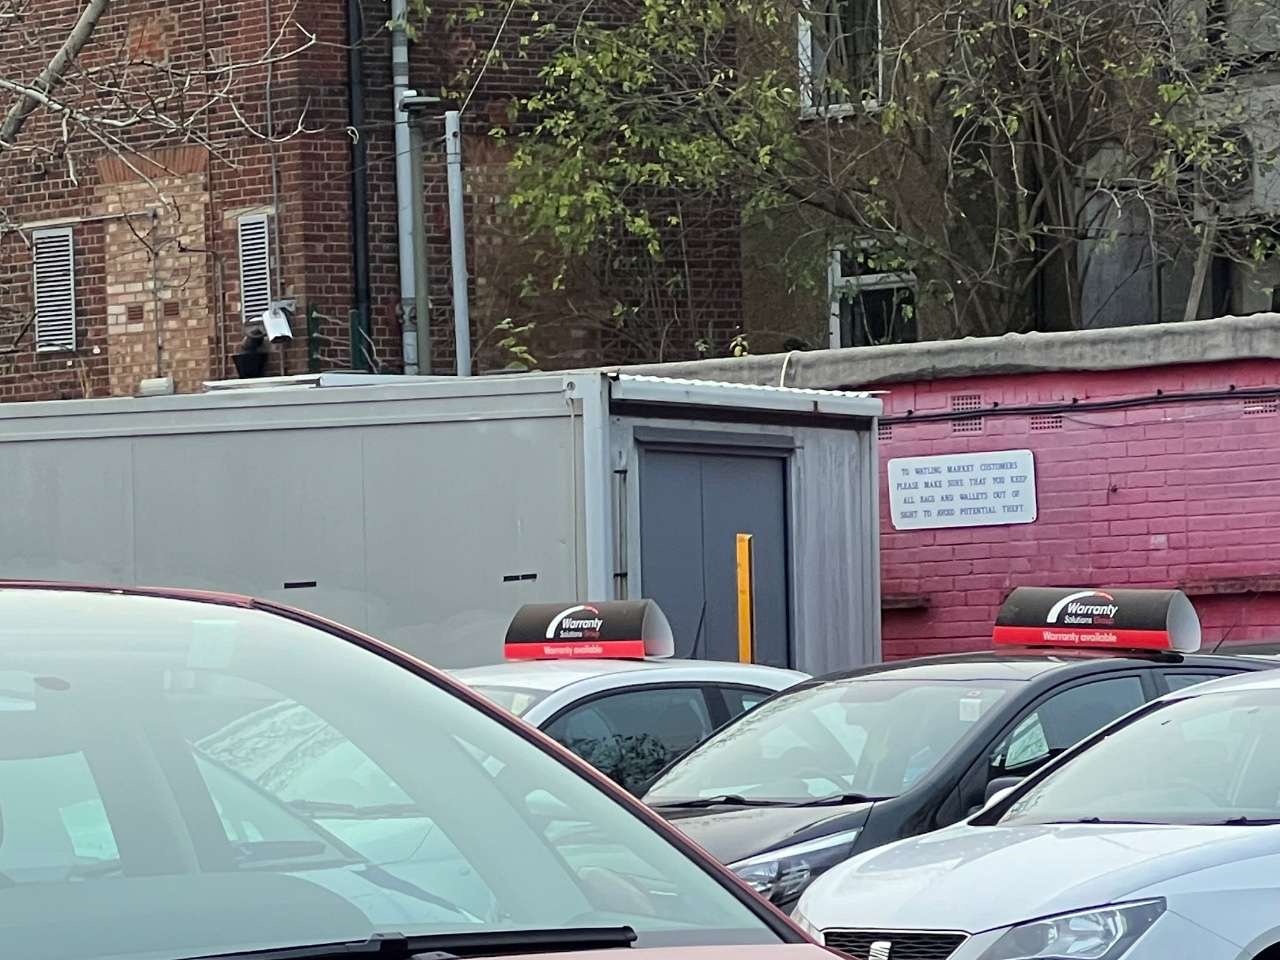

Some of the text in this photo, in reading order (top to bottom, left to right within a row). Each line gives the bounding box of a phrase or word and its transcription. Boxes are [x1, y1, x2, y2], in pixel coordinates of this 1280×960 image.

[947, 465, 974, 473] MARKET
[980, 462, 1018, 471] CUSTOMERS
[896, 482, 919, 490] PLEASE
[924, 480, 942, 488] MAKE
[969, 478, 986, 486] THAT
[992, 477, 1005, 485] YOU
[960, 492, 988, 500] WALLETS
[900, 511, 917, 519] SIGHT
[960, 506, 996, 515] POTENTIAL
[1002, 504, 1023, 512] THEFT
[1067, 602, 1118, 618] Warranty
[562, 618, 603, 631] Warranty
[1064, 615, 1093, 624] Solutions
[1043, 631, 1117, 643] Warranty available
[543, 646, 572, 656] Warranty
